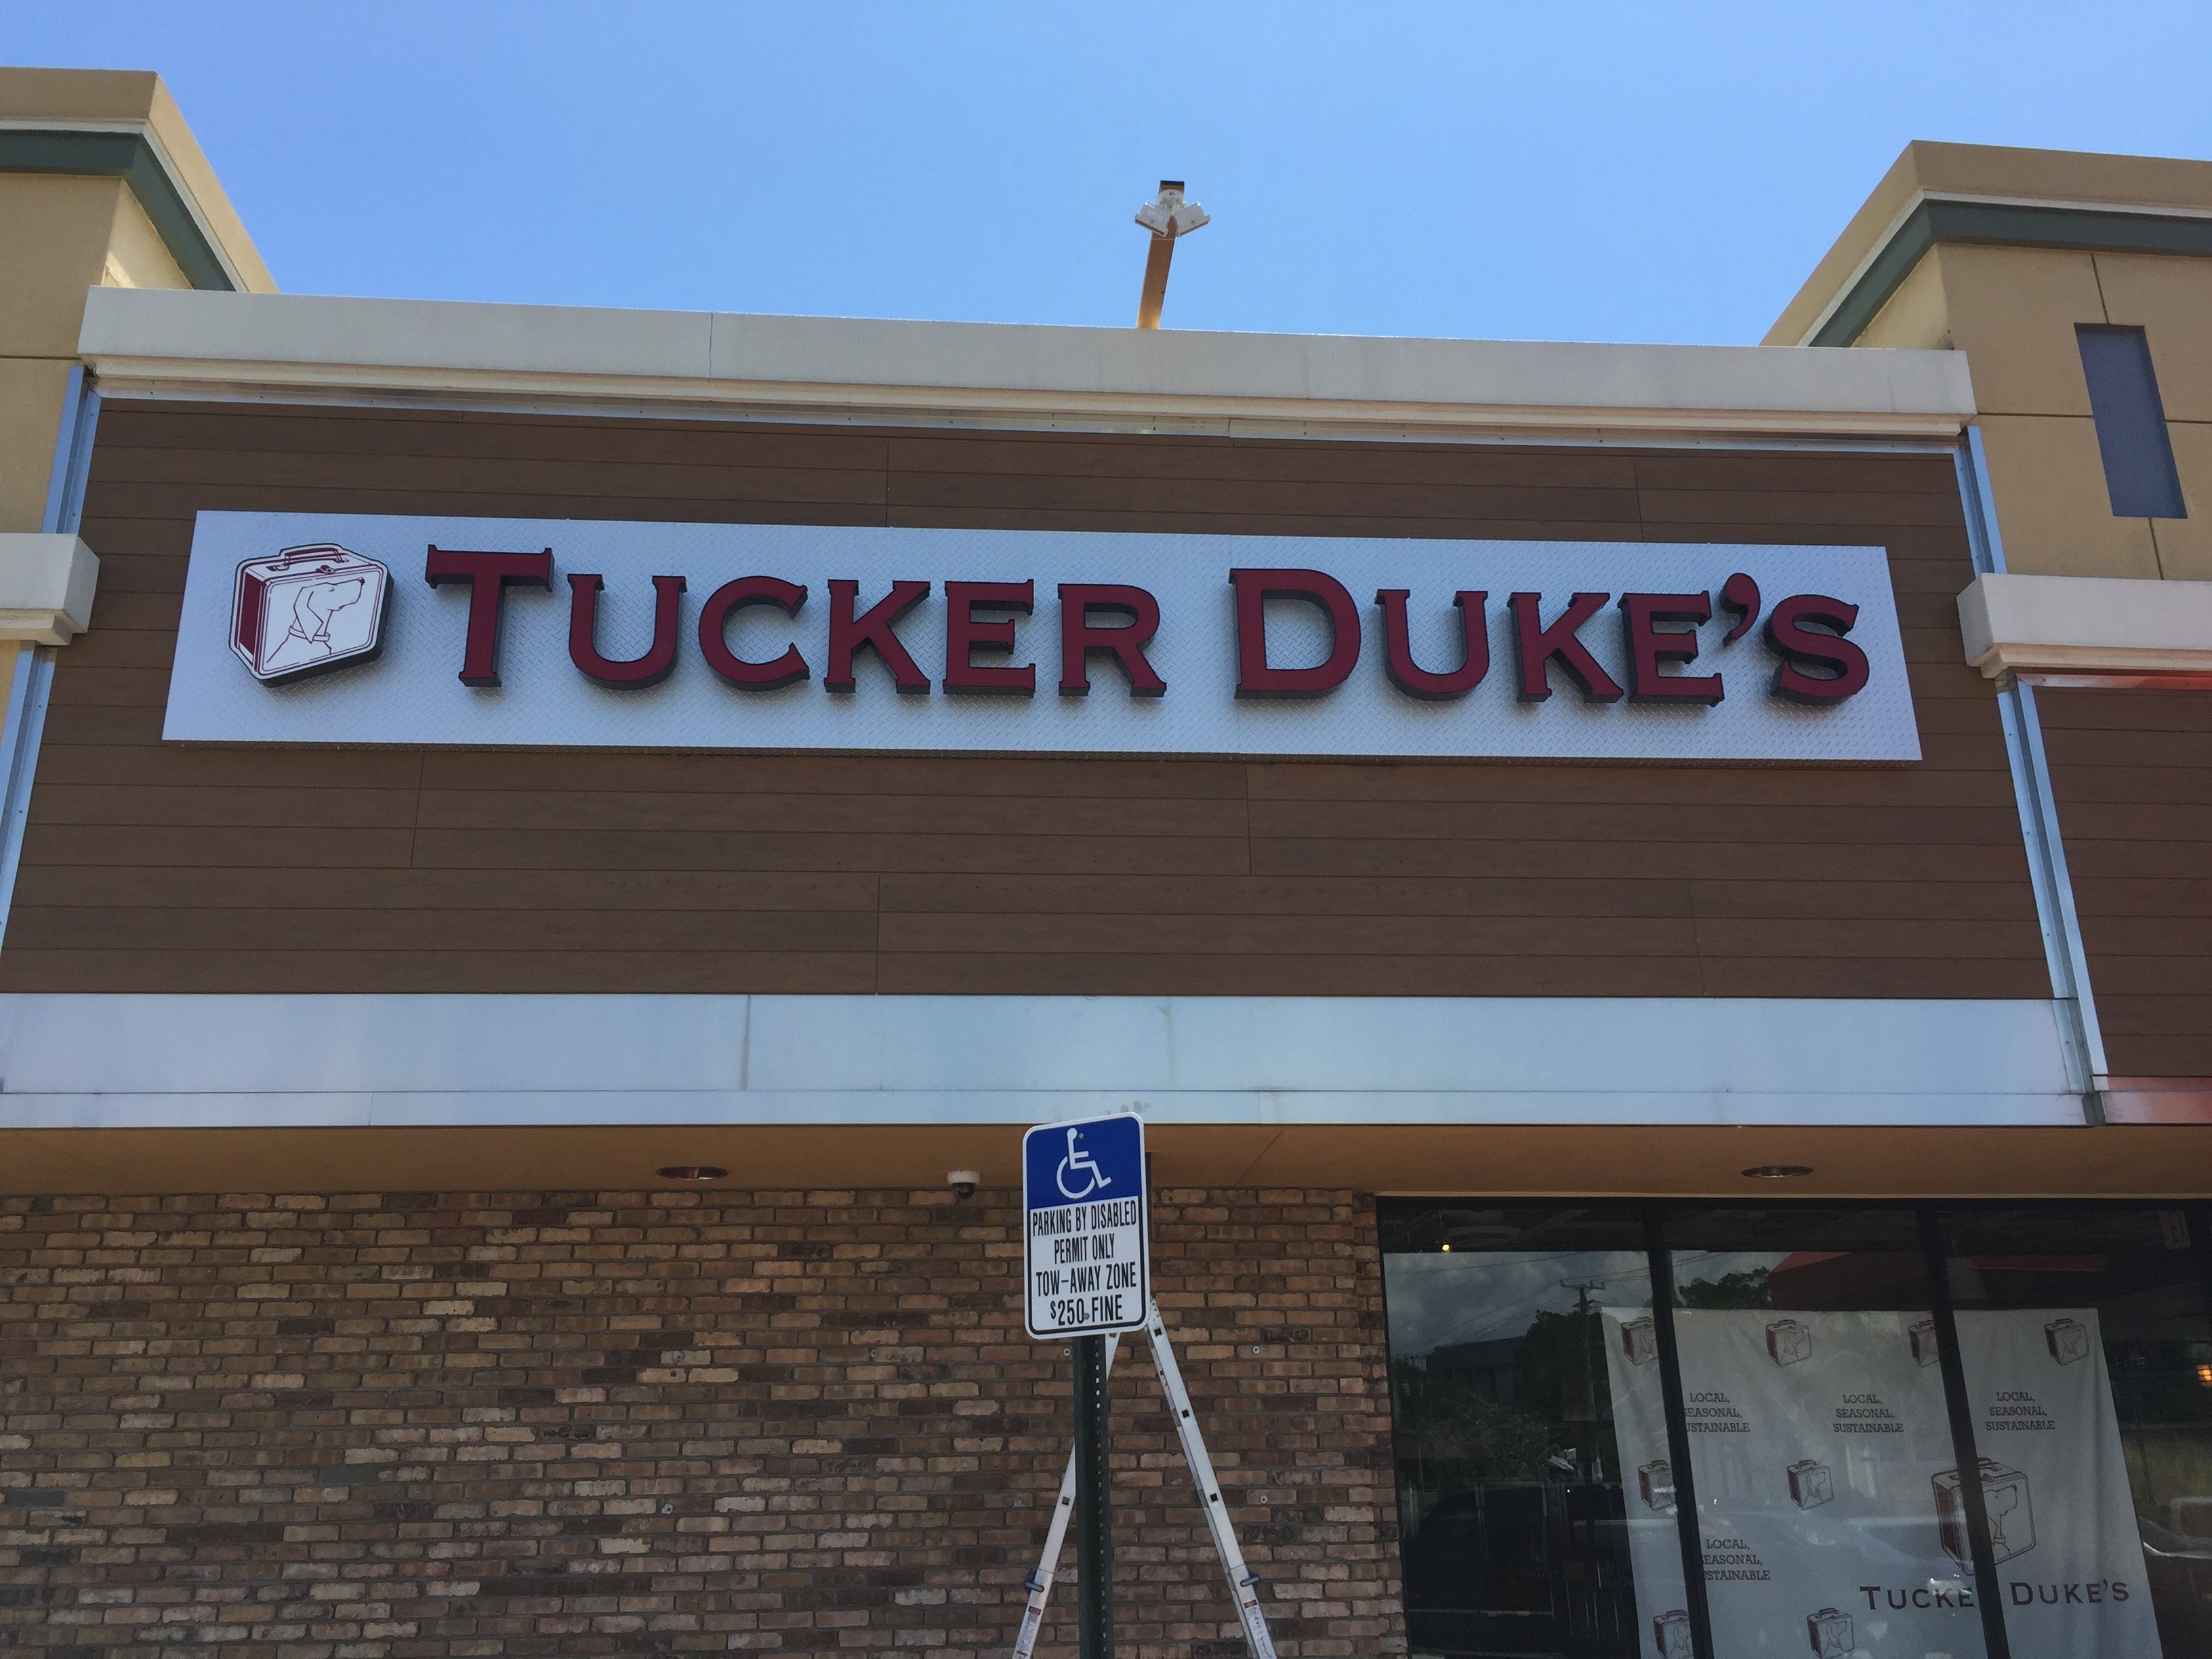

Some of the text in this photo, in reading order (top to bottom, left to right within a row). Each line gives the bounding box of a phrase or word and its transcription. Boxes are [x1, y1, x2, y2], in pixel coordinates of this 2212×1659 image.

[425, 544, 1869, 707] TUCKER DUKE'S
[1033, 1200, 1136, 1237] PARKING BY DISABLED
[1054, 1233, 1115, 1265] PERMIT ONLY
[1036, 1261, 1136, 1296] TOW-AWAY ZONE
[1050, 1294, 1124, 1326] $250 FINE
[1689, 1393, 1730, 1404] LOCAL,
[1996, 1391, 2035, 1402] LOCAL,
[1836, 1408, 1896, 1419] SEASONAL,
[1989, 1406, 2047, 1416] SEASONAL,
[1686, 1422, 1750, 1433] USTAINABLE
[1832, 1423, 1904, 1433] SUSTAINABLE
[1986, 1420, 2055, 1431] SUSTAINABLE
[1706, 1539, 1750, 1551] LOCAL,
[1702, 1555, 1763, 1565] EASONAL,
[1860, 1578, 2129, 1610] TUCKE DUKE'S
